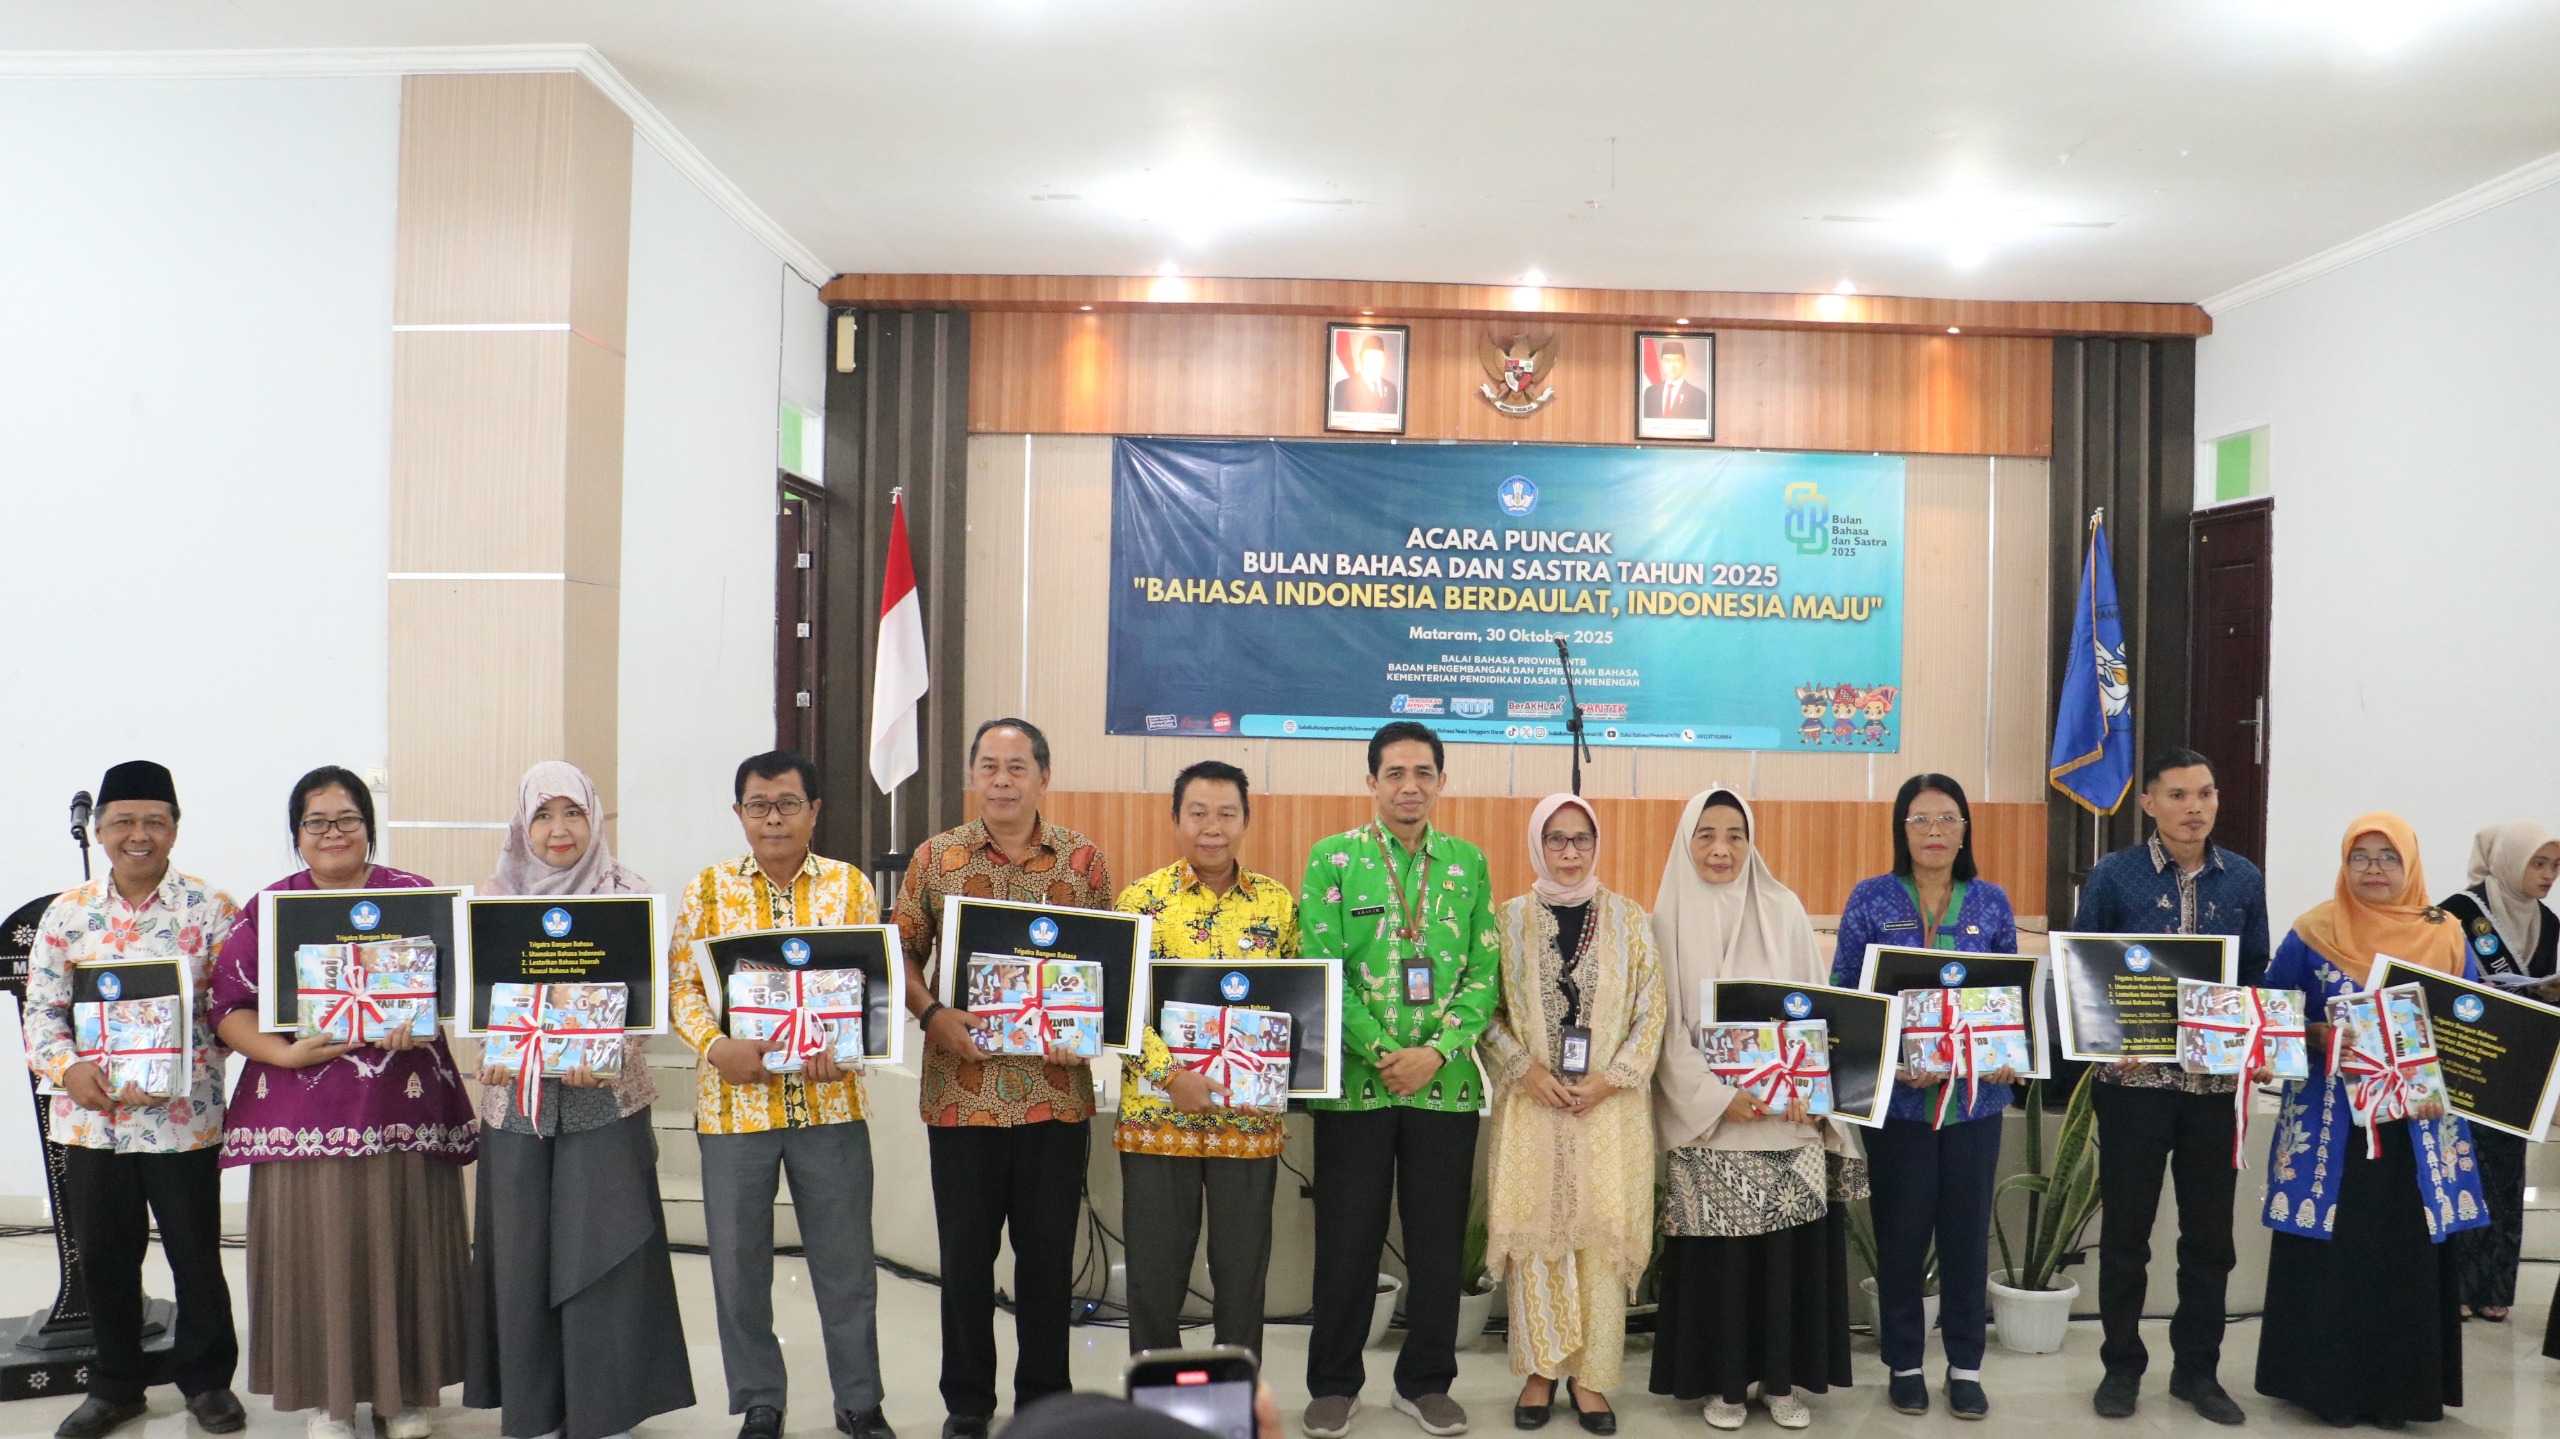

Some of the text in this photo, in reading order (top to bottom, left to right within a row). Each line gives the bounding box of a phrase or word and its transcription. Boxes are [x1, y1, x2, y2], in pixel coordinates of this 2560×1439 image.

[1832, 515, 1862, 524] Bulan
[1832, 526, 1869, 536] Bahasa
[1406, 528, 1612, 554] ACARA PUNCAK
[1831, 537, 1887, 547] dan Sastra
[1831, 548, 1856, 557] 2025
[1243, 552, 1778, 587] BULAN BAHASA DAN SASTRA TAHUN 2025
[1134, 577, 1883, 621] "BAHASA INDONESIA BERDAULAT, INDONESIA MAJU"
[1409, 626, 1482, 643] Mataram,
[1486, 628, 1506, 642] 30
[1573, 630, 1613, 644] 2025
[1441, 654, 1587, 666] BALAI BAHASA PROVINS NTB
[1388, 663, 1424, 672] BADAN
[1426, 665, 1510, 674] PENGEMBANGAN
[1512, 667, 1534, 675] DAN
[1598, 669, 1639, 677] BAHASA
[1386, 673, 1457, 683] KEMENTERIAN
[1460, 675, 1521, 684] PENDIDIKAN
[1523, 677, 1558, 685] DASAR
[1585, 678, 1640, 687] MENENGAH
[1508, 701, 1562, 711] BerAKHLAK
